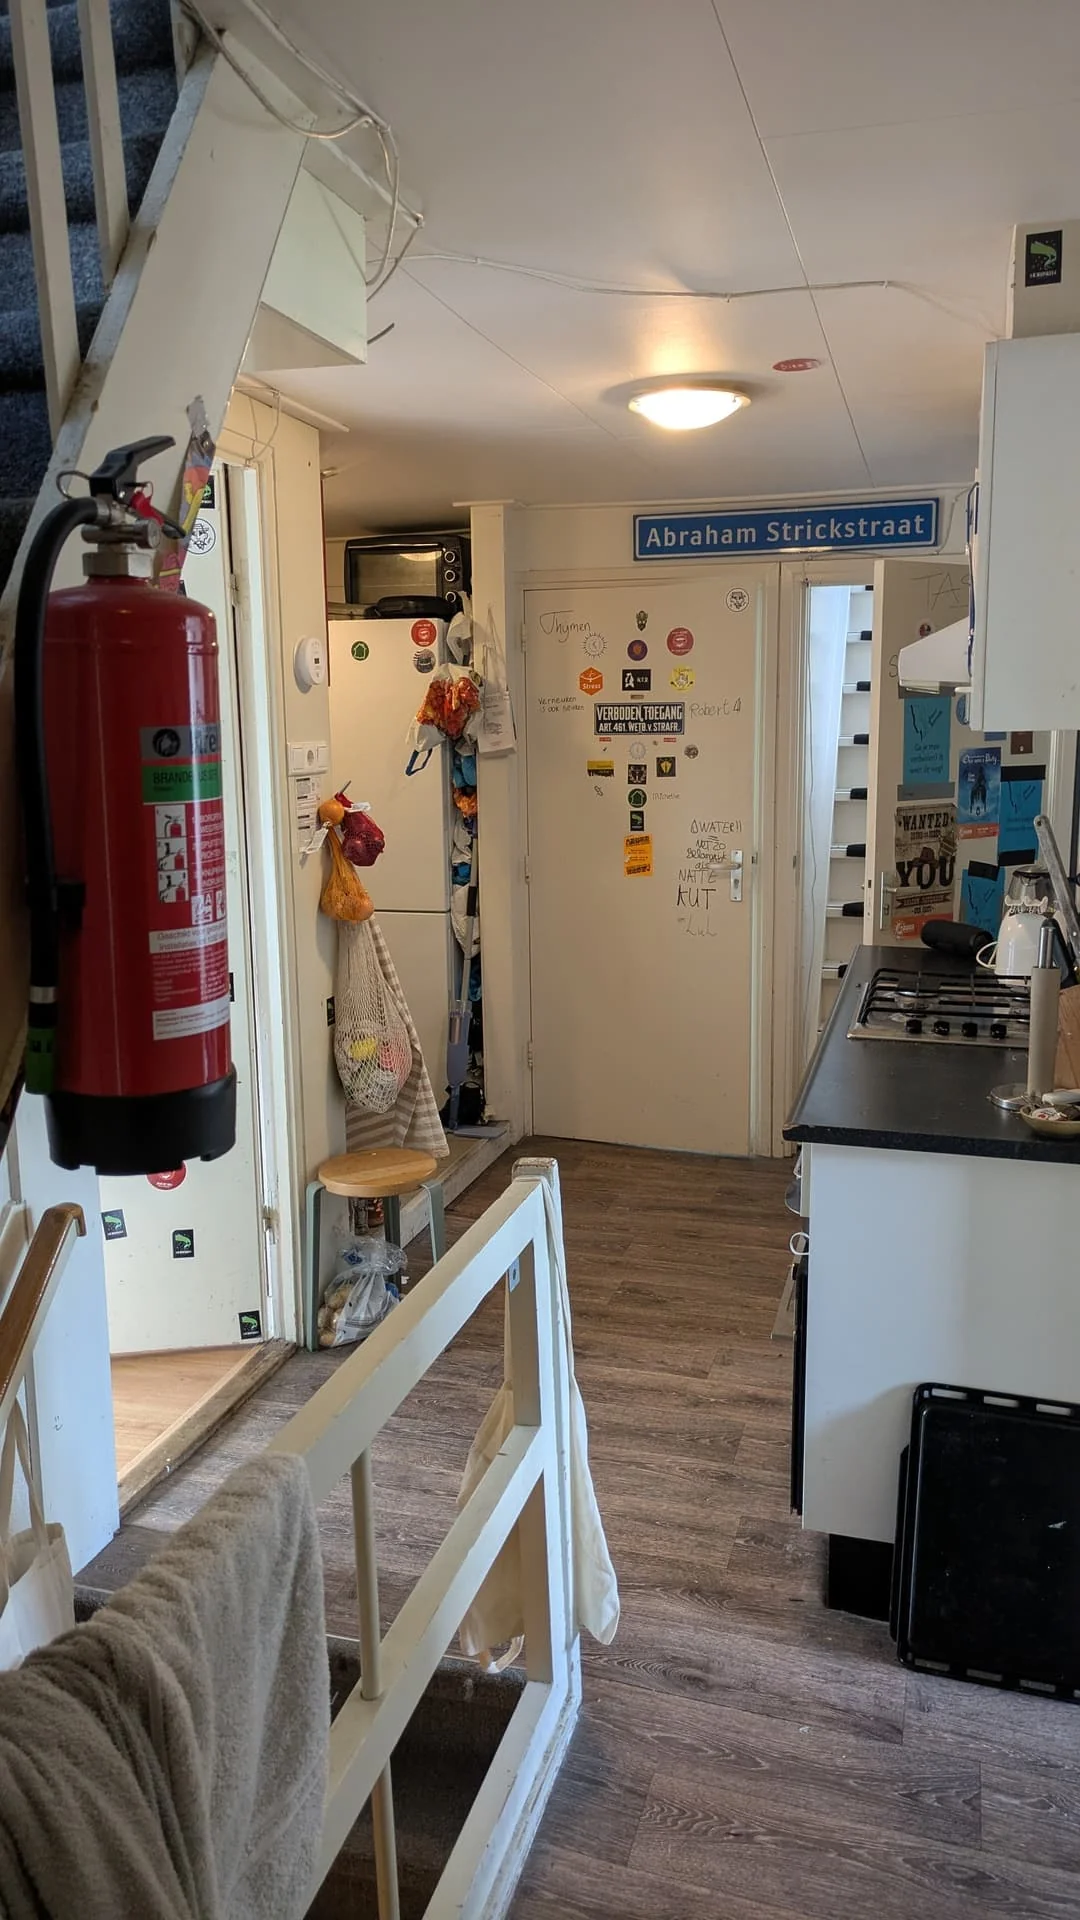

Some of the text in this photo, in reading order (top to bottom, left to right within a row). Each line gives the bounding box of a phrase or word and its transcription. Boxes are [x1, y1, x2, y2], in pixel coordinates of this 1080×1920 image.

[646, 514, 924, 548] Abraham Strickstraat
[540, 609, 591, 643] Thymen
[596, 705, 683, 721] VERBODEN TOEGANG
[689, 698, 730, 719] Robert
[599, 723, 613, 732] ART.
[653, 722, 680, 731] STRAFR.
[902, 812, 950, 831] WANTED
[678, 868, 718, 884] NATTE
[896, 855, 956, 890] YOU
[676, 883, 717, 910] KUT
